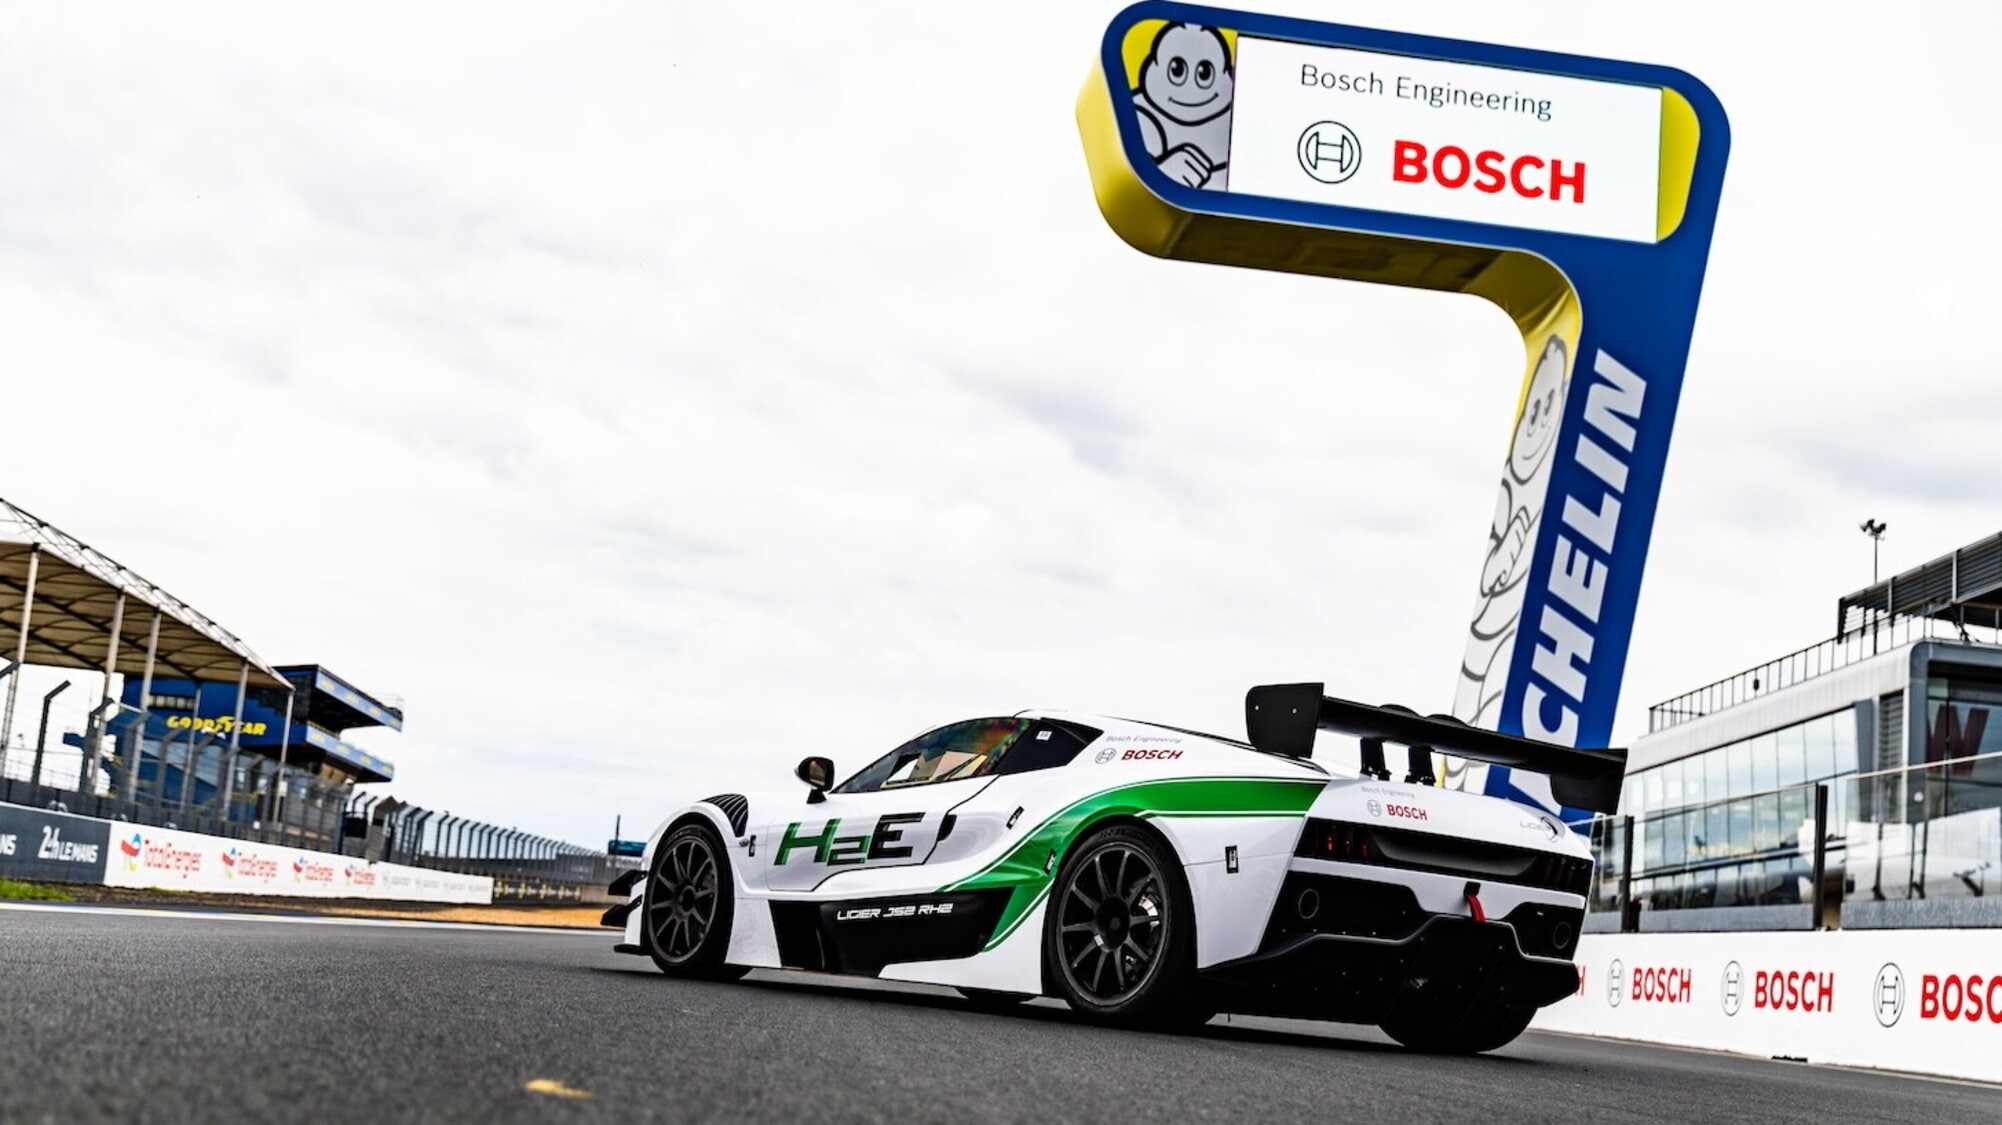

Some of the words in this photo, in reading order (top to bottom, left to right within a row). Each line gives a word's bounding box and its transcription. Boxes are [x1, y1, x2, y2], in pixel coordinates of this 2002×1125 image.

[1300, 63, 1383, 95] Bosch
[1396, 76, 1552, 121] Engineering
[1393, 139, 1585, 203] BOSCH
[1508, 348, 1647, 817] ICHELIN
[166, 715, 267, 736] GOODYAR
[1121, 749, 1184, 761] BOSCH
[1386, 803, 1428, 821] BOSCH
[774, 812, 926, 866] H2E
[1632, 968, 1692, 1003] BOSCH
[1754, 971, 1834, 1012] BOSCH
[1920, 974, 2002, 1024] BOSC
